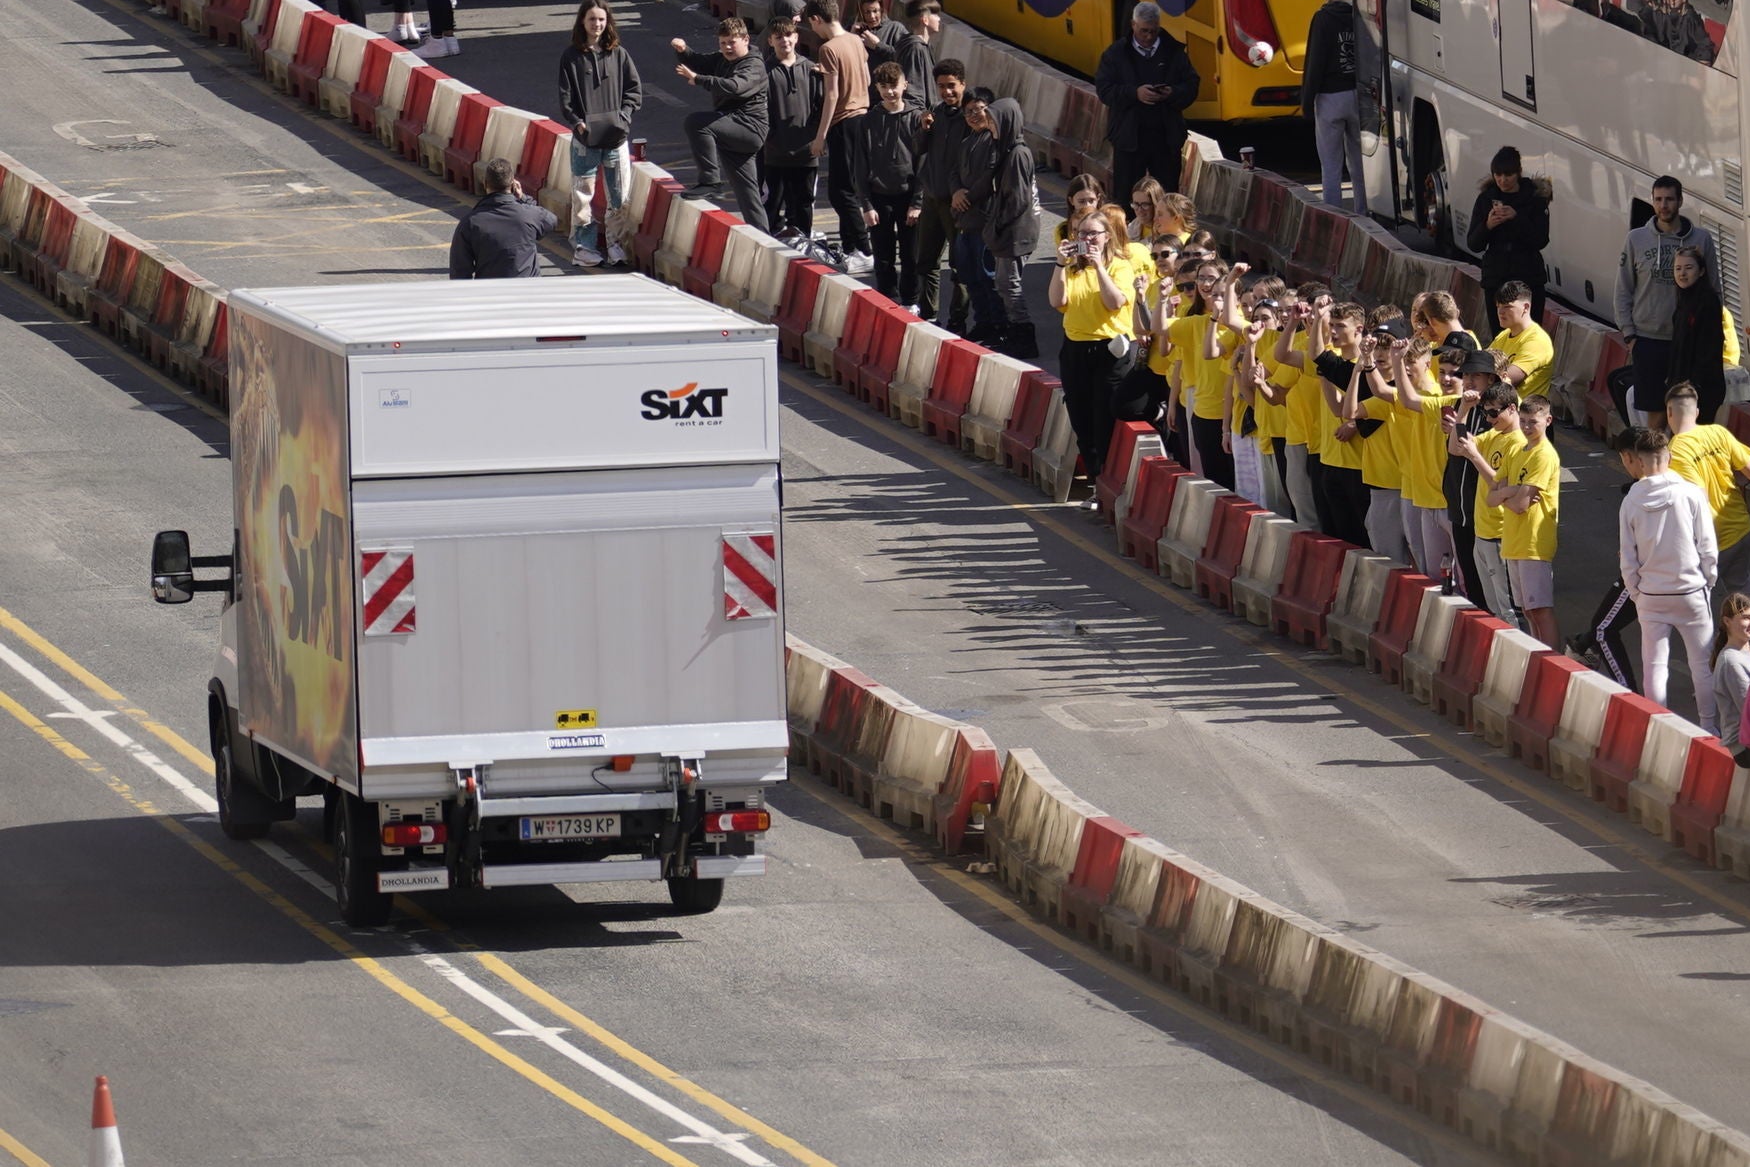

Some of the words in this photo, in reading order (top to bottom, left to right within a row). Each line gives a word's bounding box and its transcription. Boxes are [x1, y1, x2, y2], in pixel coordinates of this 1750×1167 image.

[640, 382, 728, 421] SIXT
[278, 484, 344, 663] SIXT
[548, 735, 606, 750] DHOLLANDIA
[534, 820, 546, 832] W
[557, 818, 593, 834] 1739
[596, 818, 615, 833] KP
[381, 876, 439, 887] DHOLLANDIA
